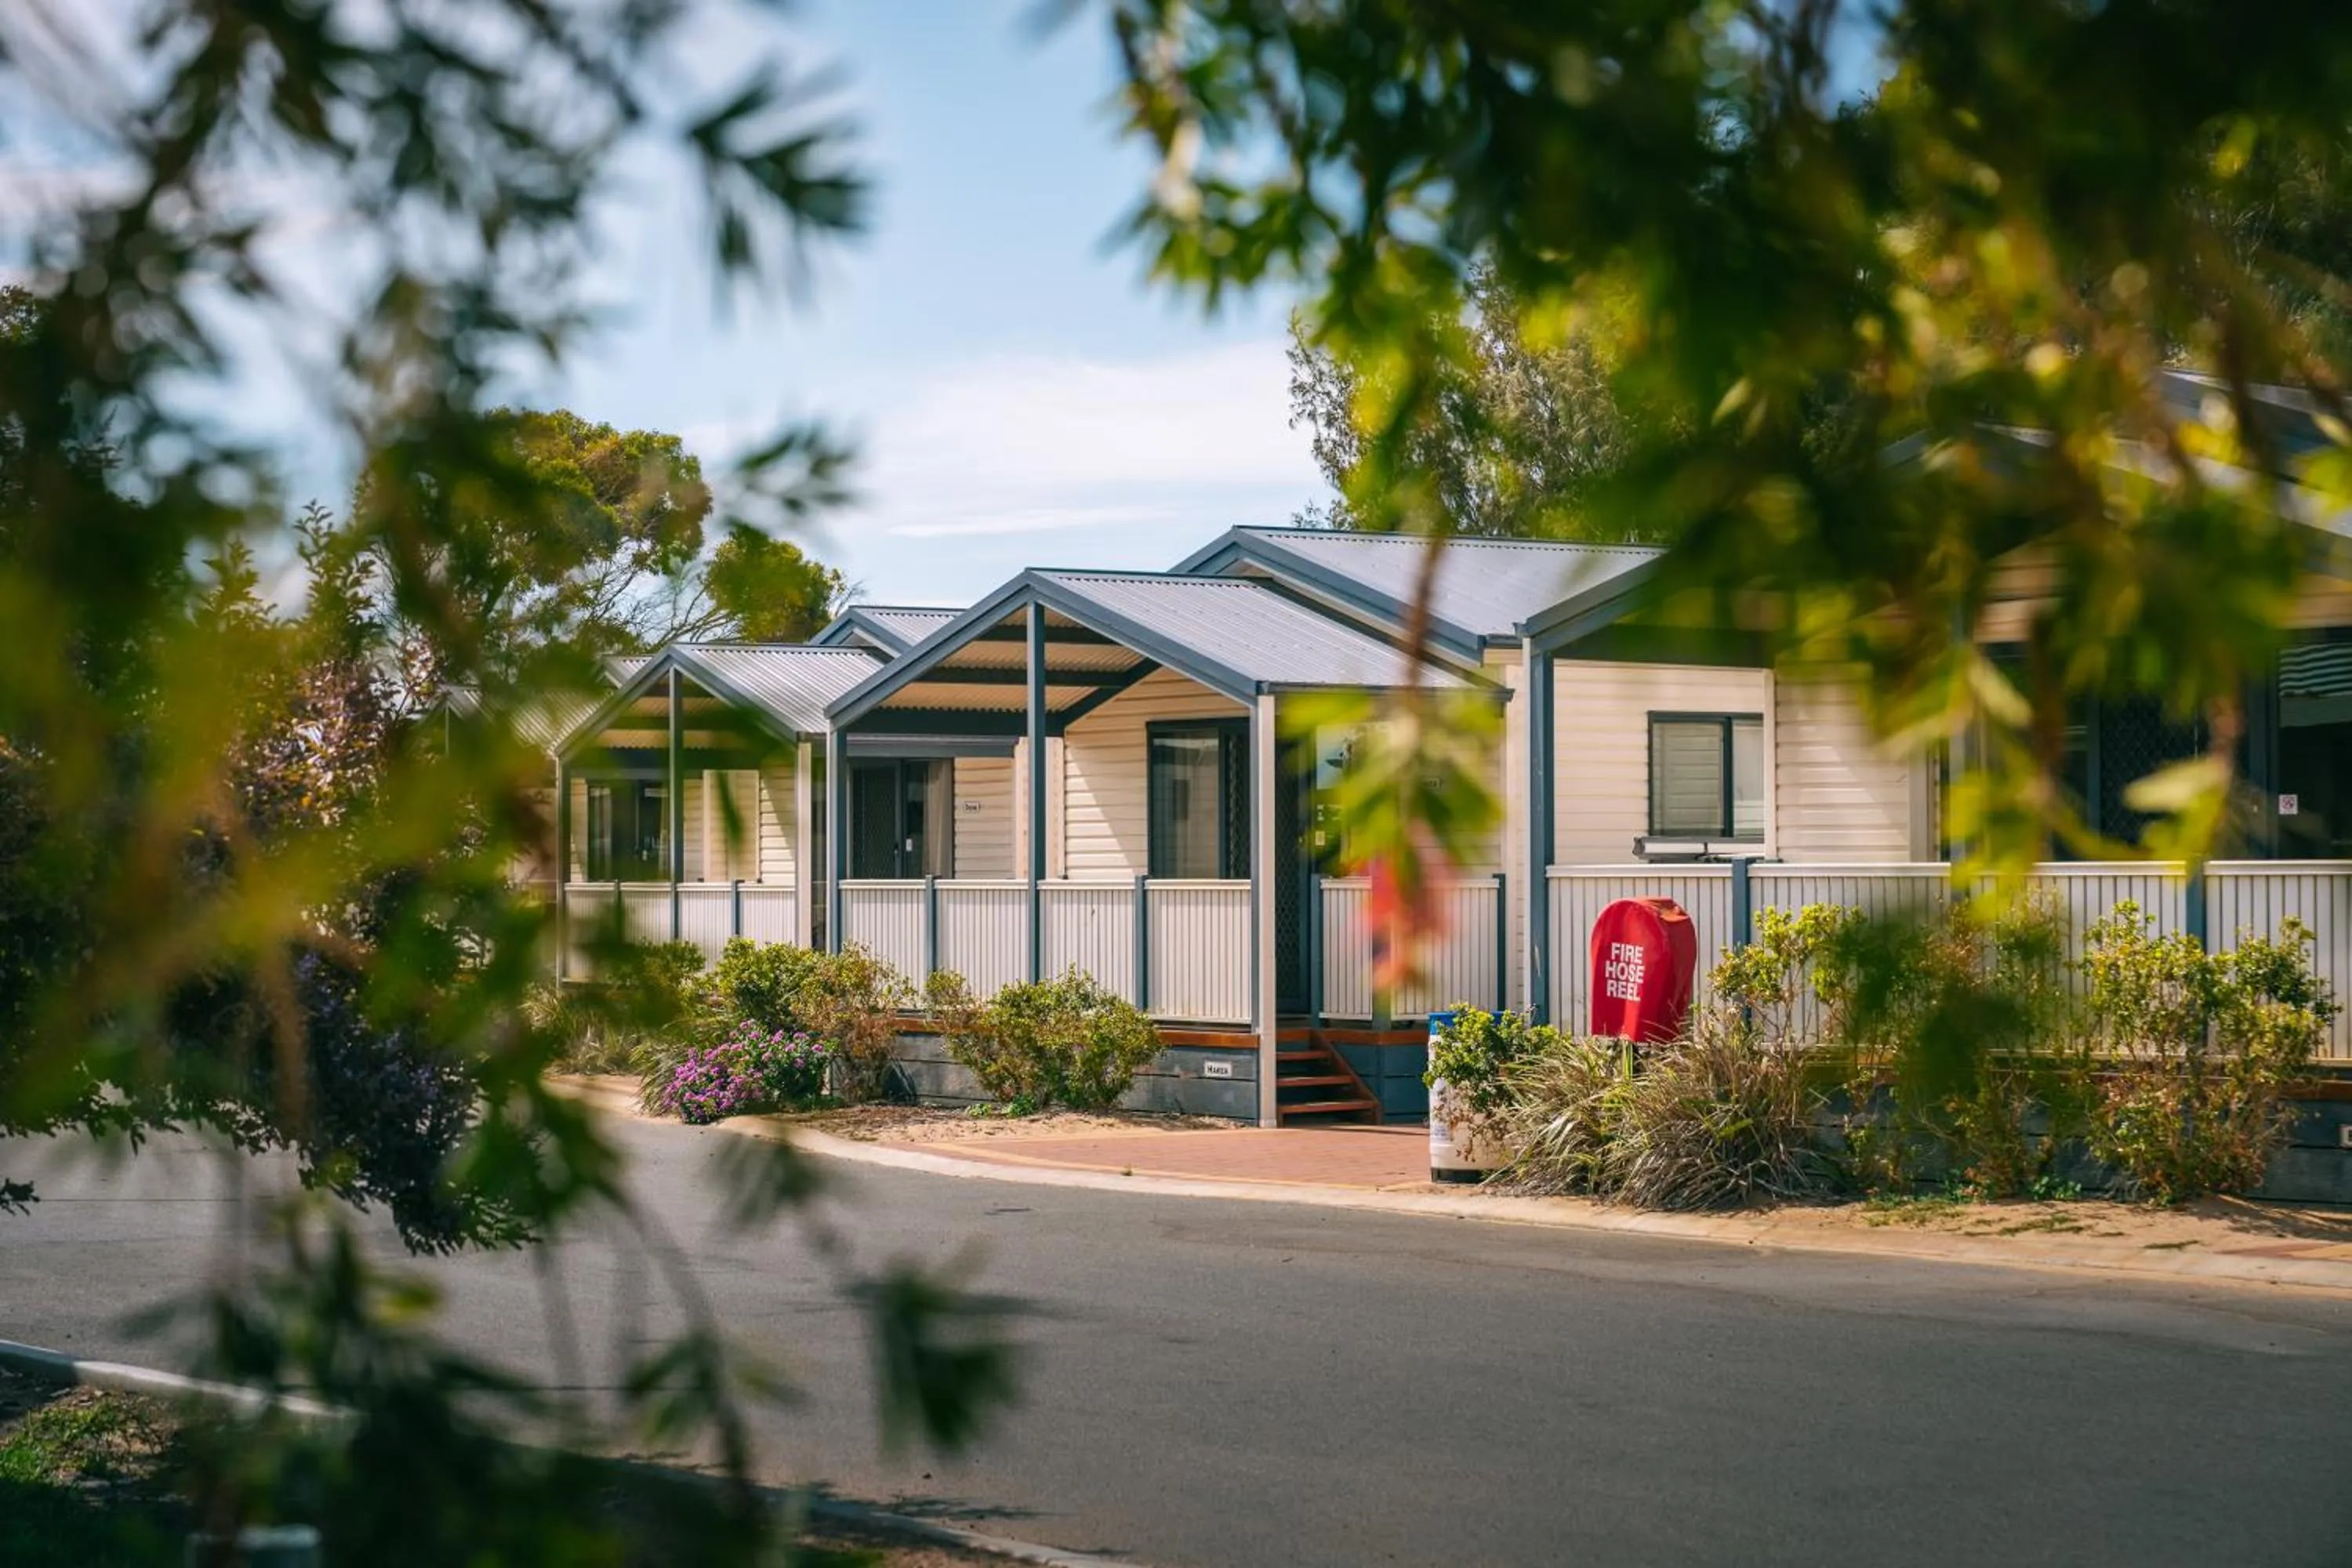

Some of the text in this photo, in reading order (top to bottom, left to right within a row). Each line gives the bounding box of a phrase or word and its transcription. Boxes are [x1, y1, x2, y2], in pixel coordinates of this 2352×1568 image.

[1611, 942, 1644, 964] FIRE
[1605, 960, 1644, 984] HOSE
[1606, 979, 1641, 1001] REEL
